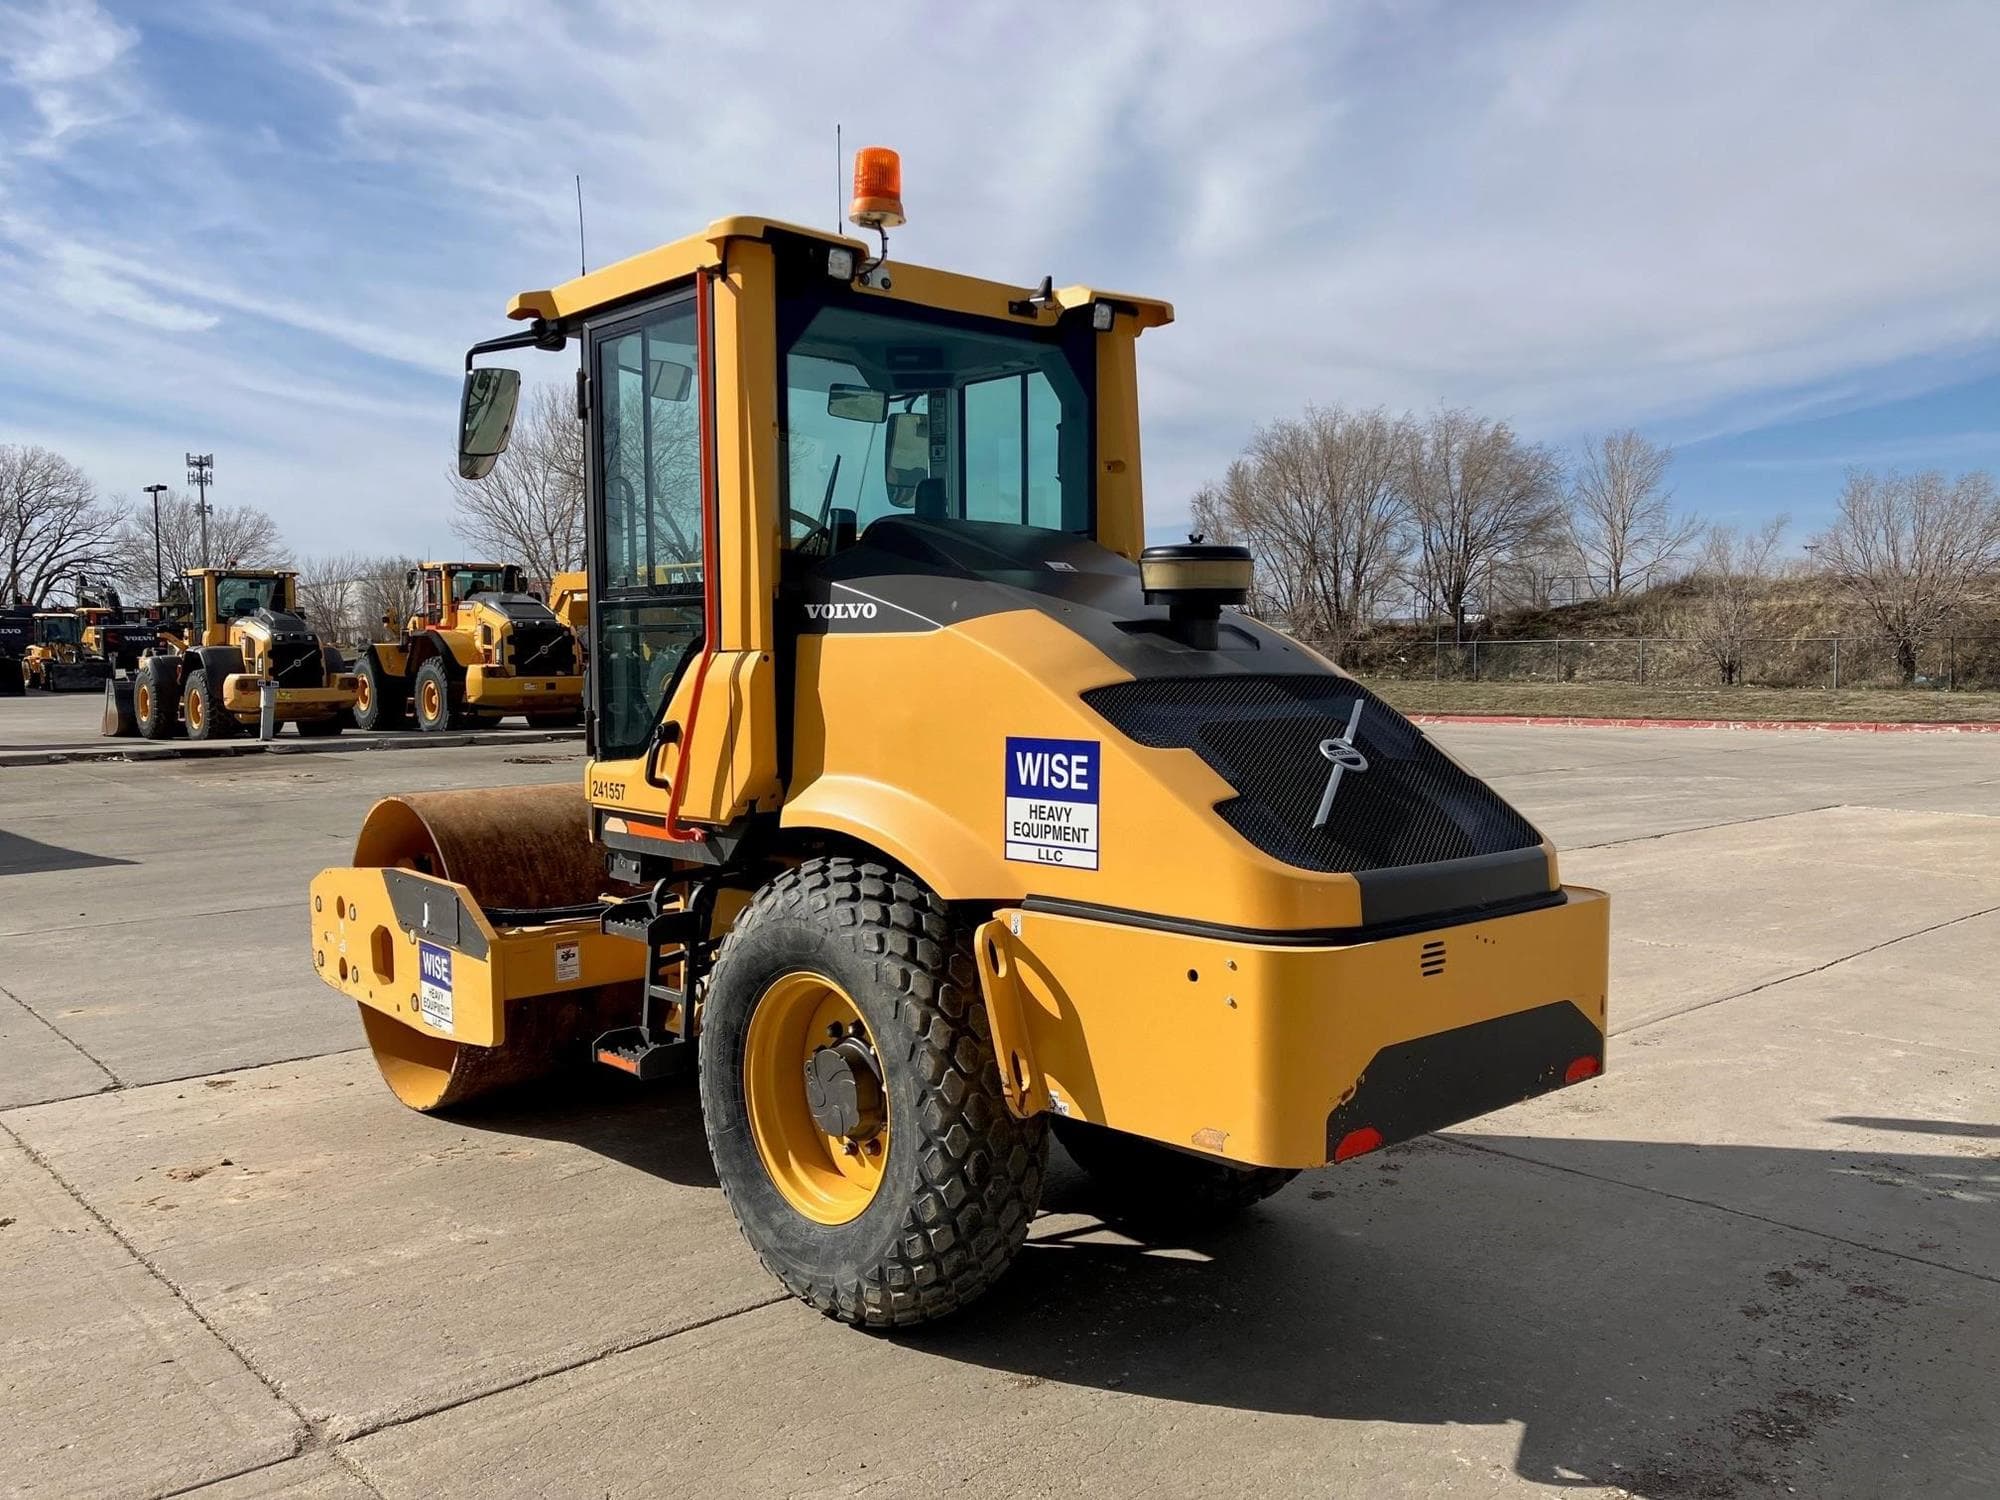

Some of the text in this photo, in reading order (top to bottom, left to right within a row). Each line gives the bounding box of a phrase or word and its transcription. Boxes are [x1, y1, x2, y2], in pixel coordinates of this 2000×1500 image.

[804, 602, 878, 619] VOLVO
[1016, 751, 1089, 790] WISE
[592, 780, 626, 800] 241557
[1029, 804, 1072, 823] HEAVY
[1013, 821, 1089, 844] EQUIPMENT
[1038, 848, 1063, 862] LLC
[422, 950, 449, 983] WISE
